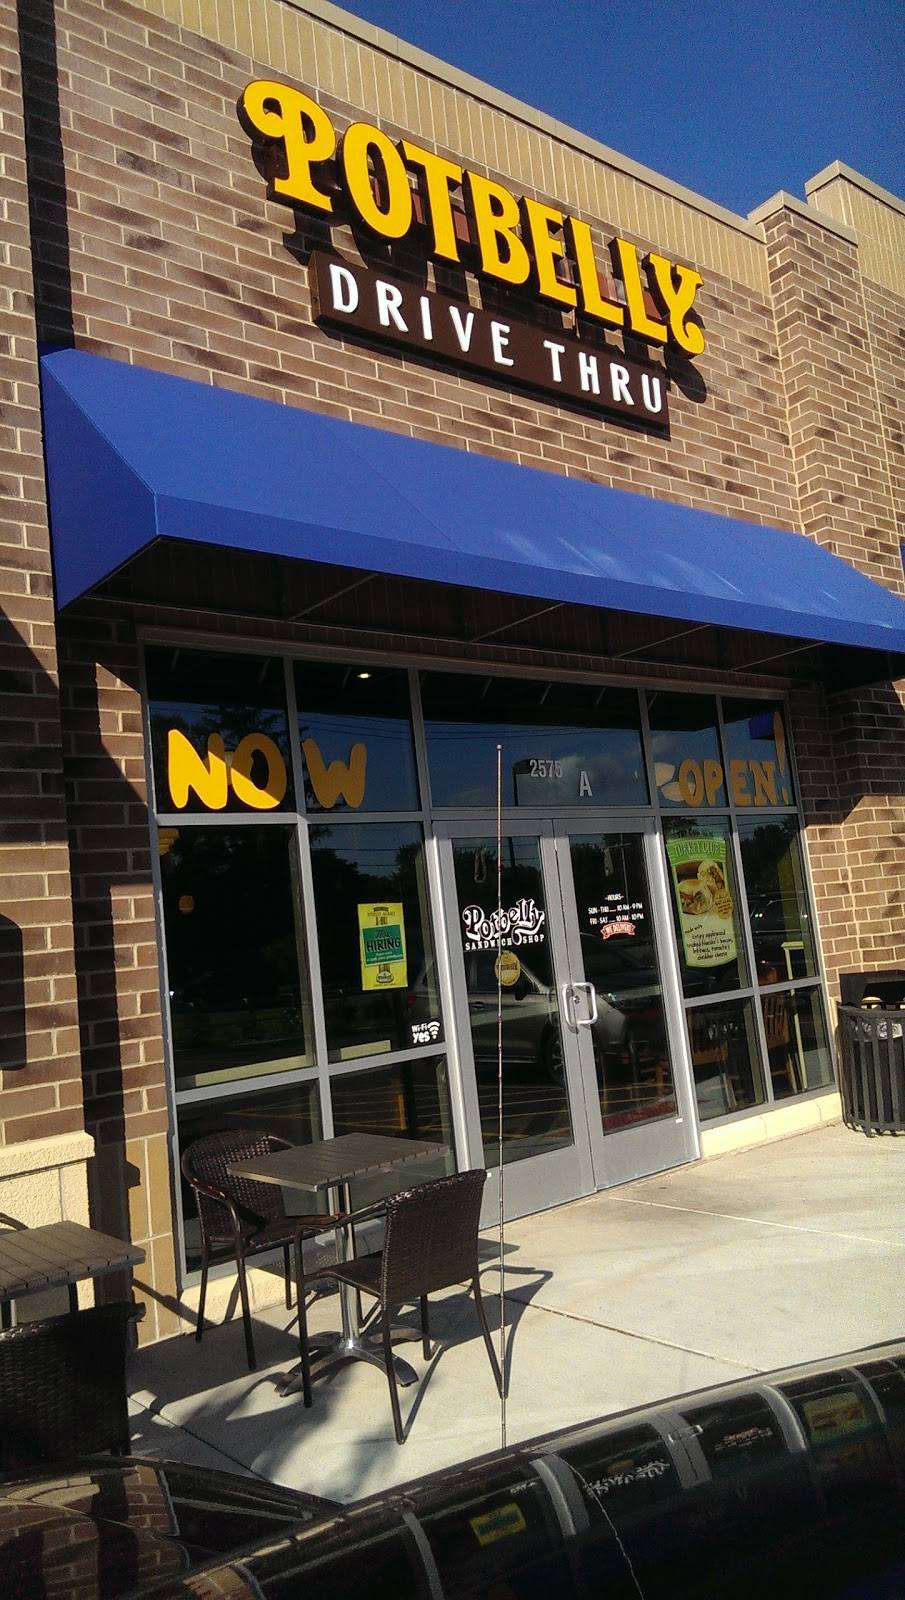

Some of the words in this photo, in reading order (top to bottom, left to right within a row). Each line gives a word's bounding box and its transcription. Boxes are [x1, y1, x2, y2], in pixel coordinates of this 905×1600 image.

[241, 79, 705, 355] POTBELLY
[328, 262, 514, 367] DRIVE
[543, 338, 663, 415] THRU
[167, 728, 367, 810] NOW
[528, 758, 563, 779] 2575
[579, 770, 593, 797] A
[462, 898, 545, 945] Potbelly
[366, 936, 401, 953] HIRING
[522, 934, 545, 945] SHOP
[411, 1023, 429, 1032] Wi-Fi
[412, 1031, 431, 1044] yes
